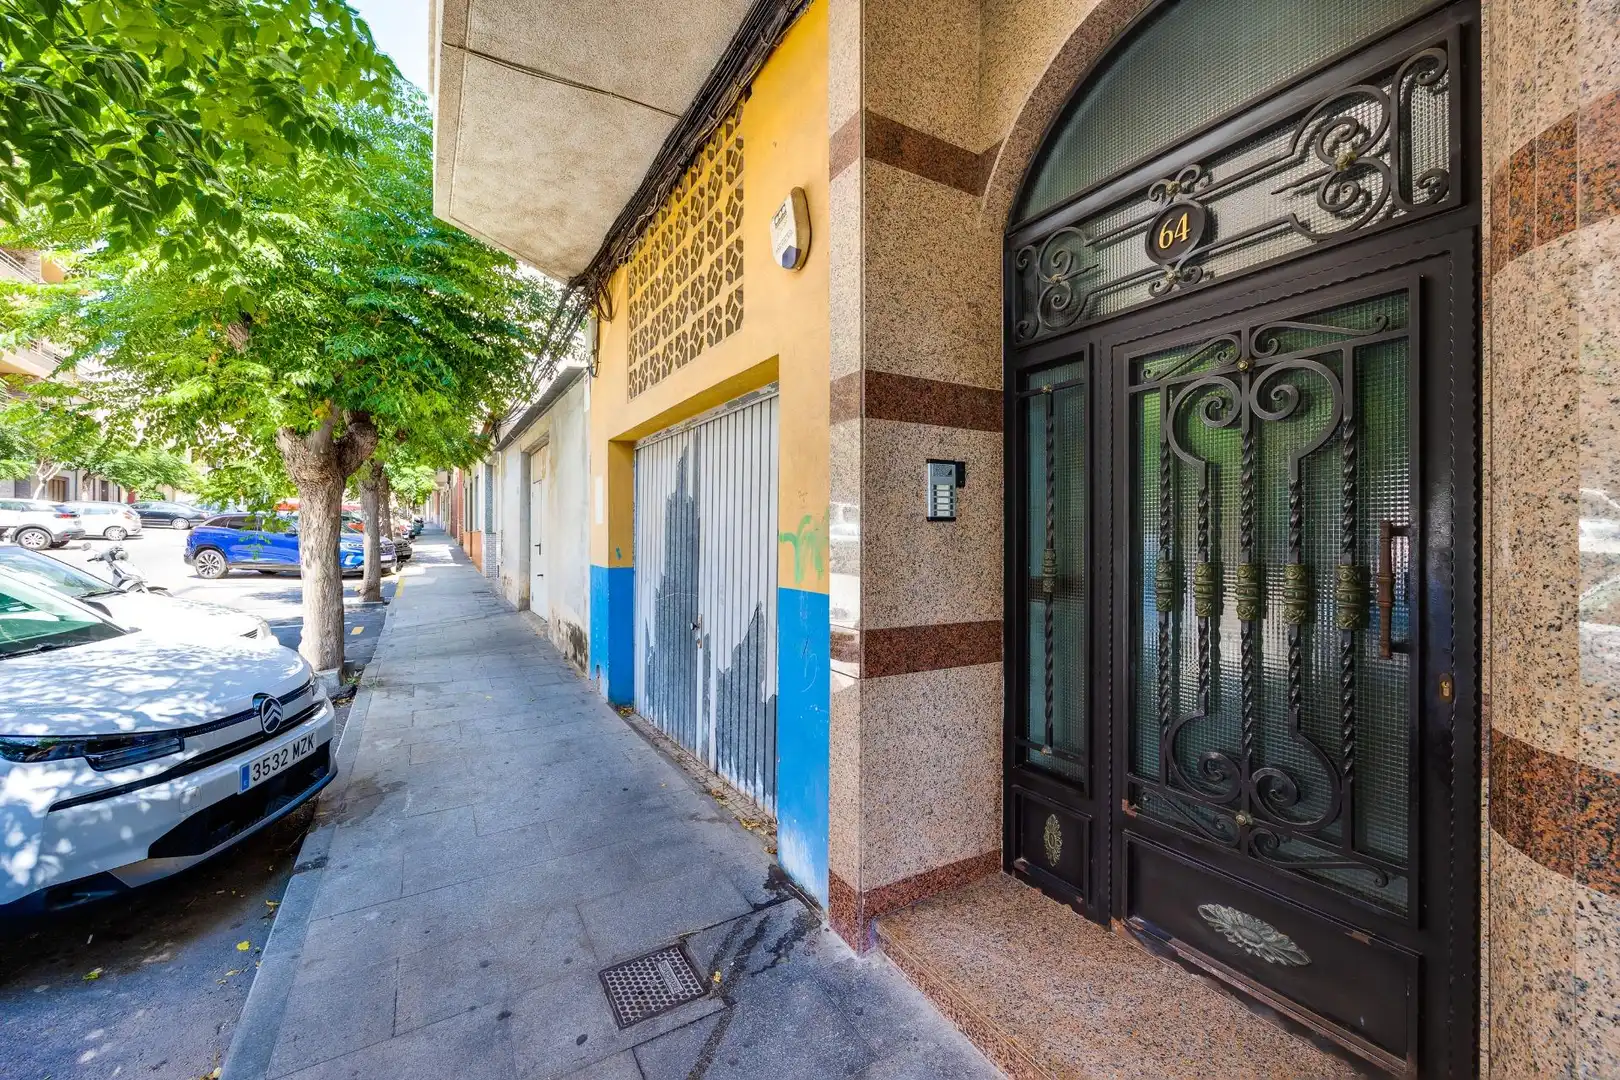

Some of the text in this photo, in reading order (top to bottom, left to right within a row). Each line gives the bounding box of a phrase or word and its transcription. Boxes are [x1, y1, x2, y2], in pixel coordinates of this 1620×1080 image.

[1158, 213, 1191, 249] 64
[252, 732, 315, 782] 3532 MZK
